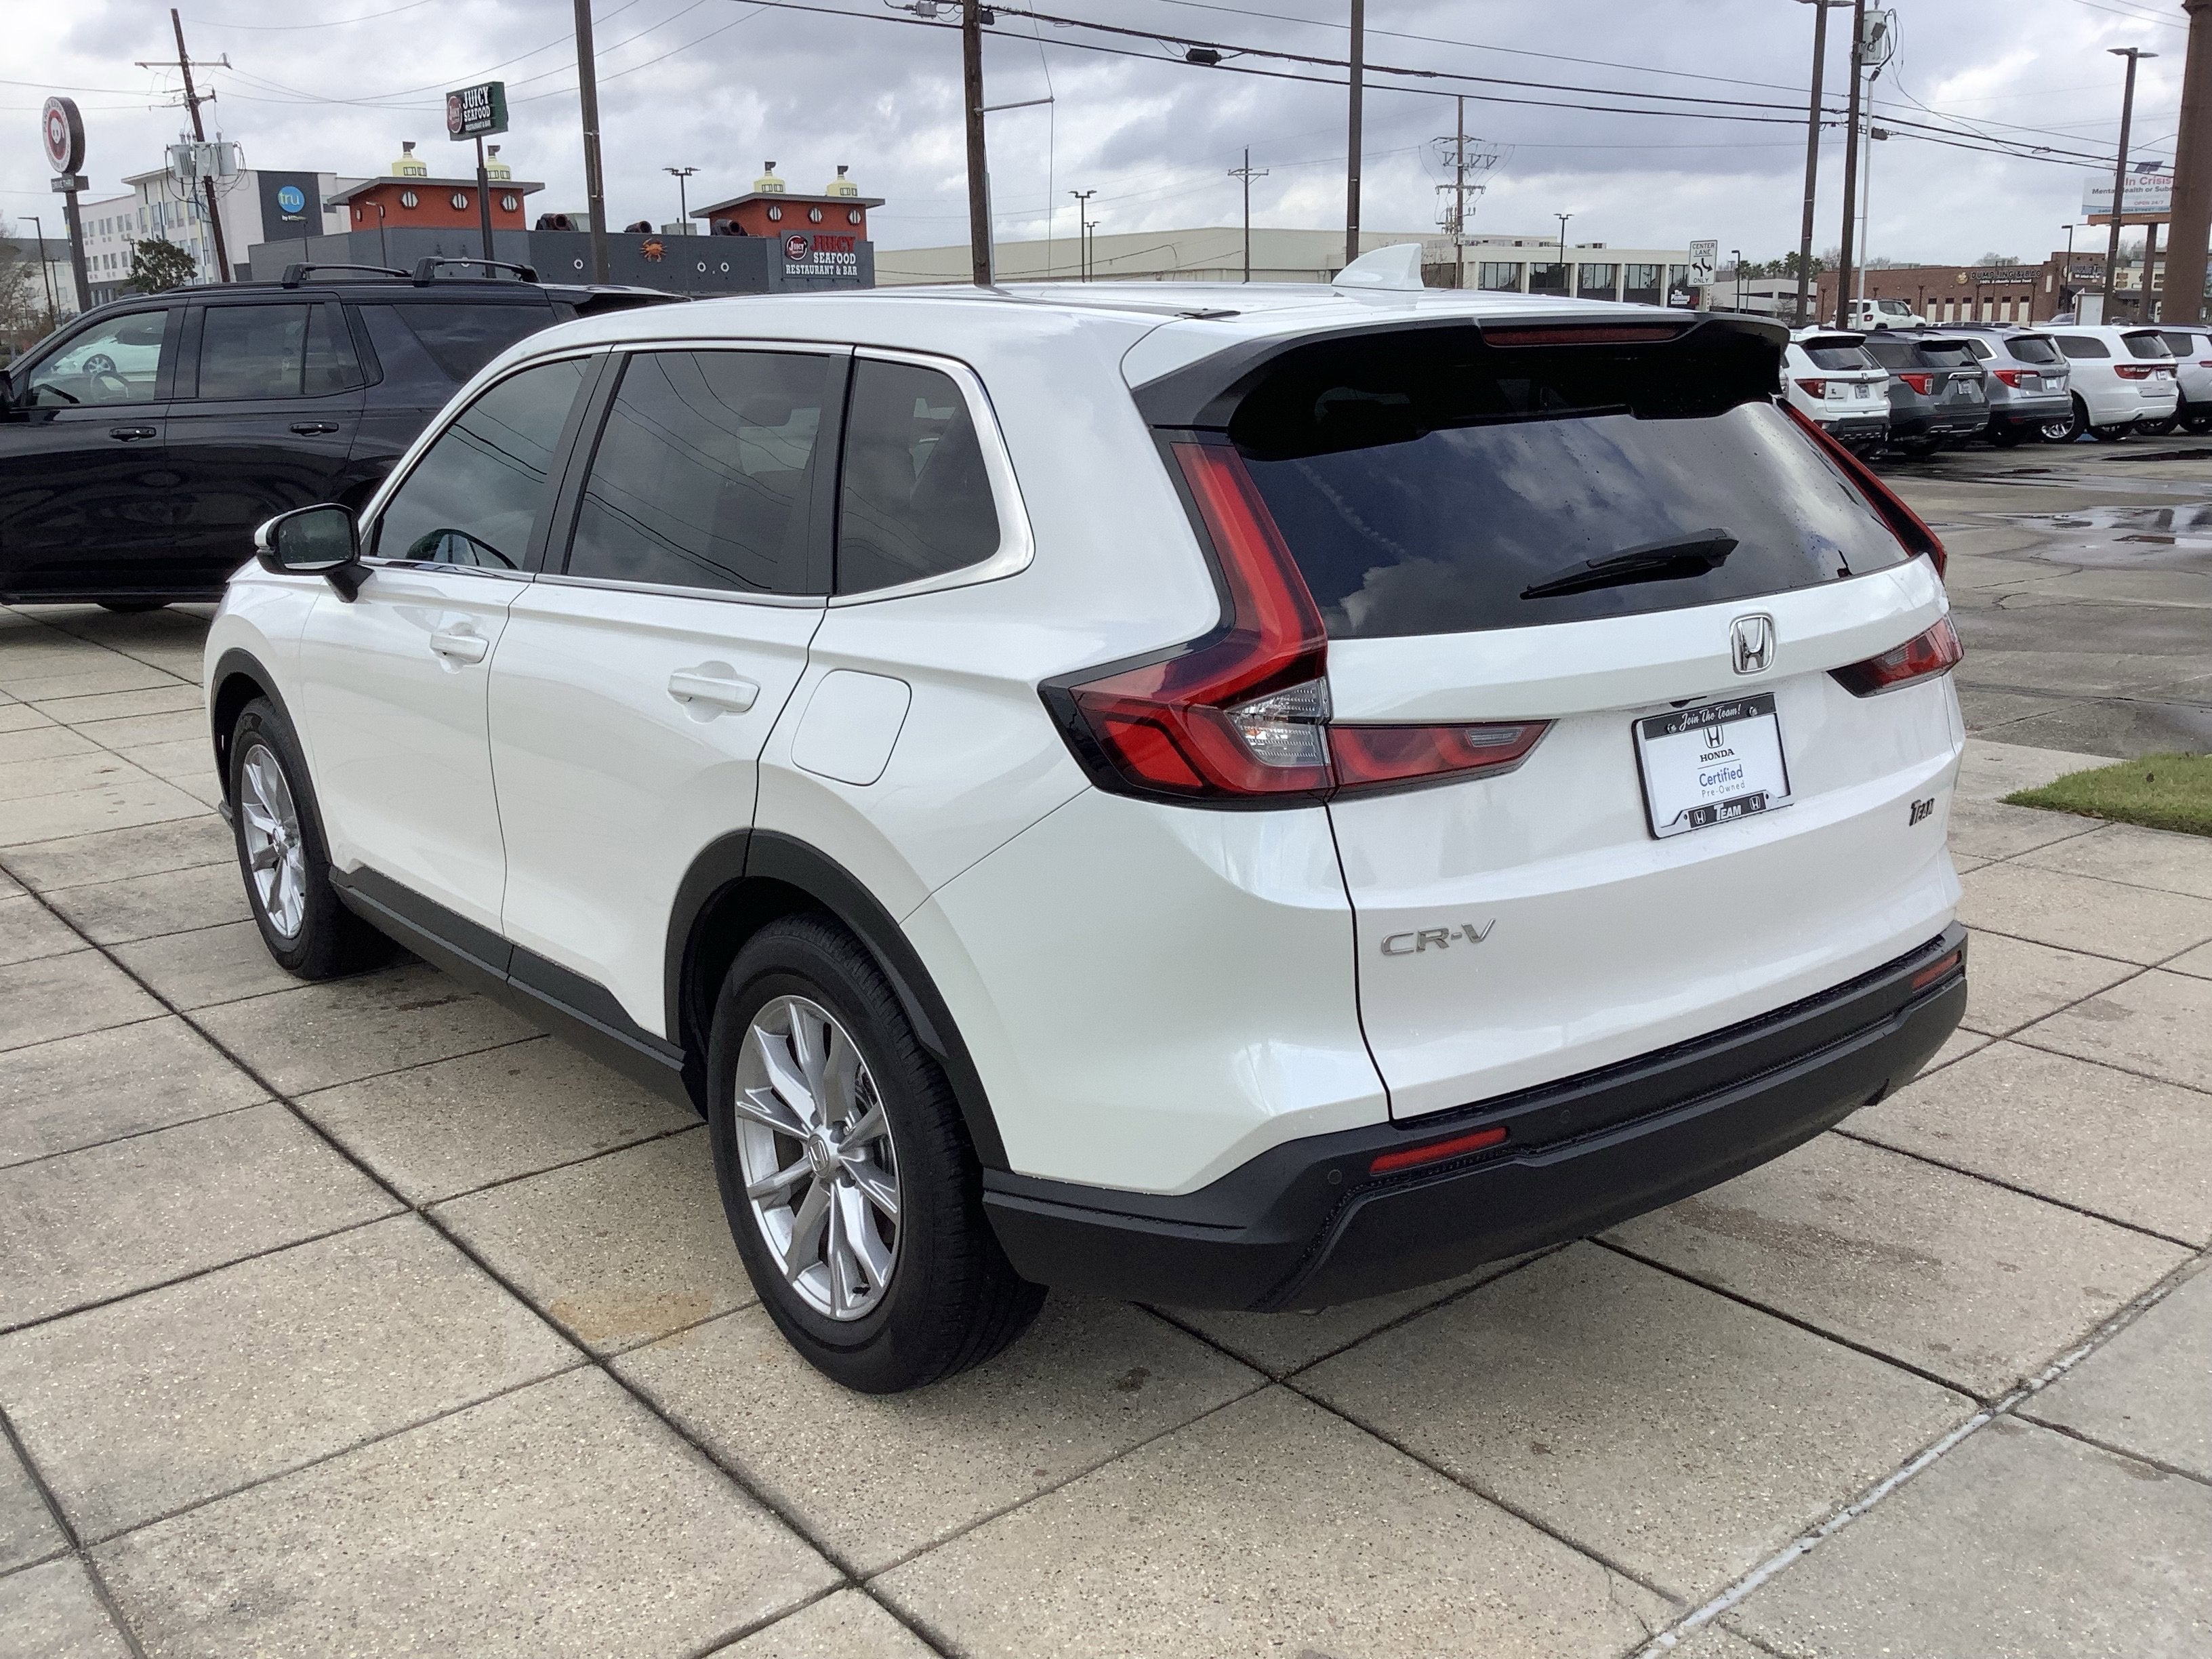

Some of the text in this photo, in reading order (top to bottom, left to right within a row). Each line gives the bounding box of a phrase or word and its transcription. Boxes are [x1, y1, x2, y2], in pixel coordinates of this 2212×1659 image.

[463, 86, 489, 109] JUICY
[464, 105, 491, 122] SEAFOOD
[2125, 176, 2171, 186] In Crisis
[279, 192, 300, 205] tru
[810, 235, 855, 252] JUICY
[813, 251, 857, 264] SEAFOOD
[785, 264, 858, 276] RESTAURANT & BAR
[1971, 271, 2014, 280] DUMPLING
[2024, 270, 2042, 278] BAO
[1679, 703, 1742, 731] Join The Team!
[1700, 748, 1735, 762] HONDA
[1699, 764, 1743, 787] Certified
[1702, 781, 1746, 798] Pre-Owned
[1714, 803, 1742, 821] TEAM
[1380, 918, 1496, 956] CR-V
